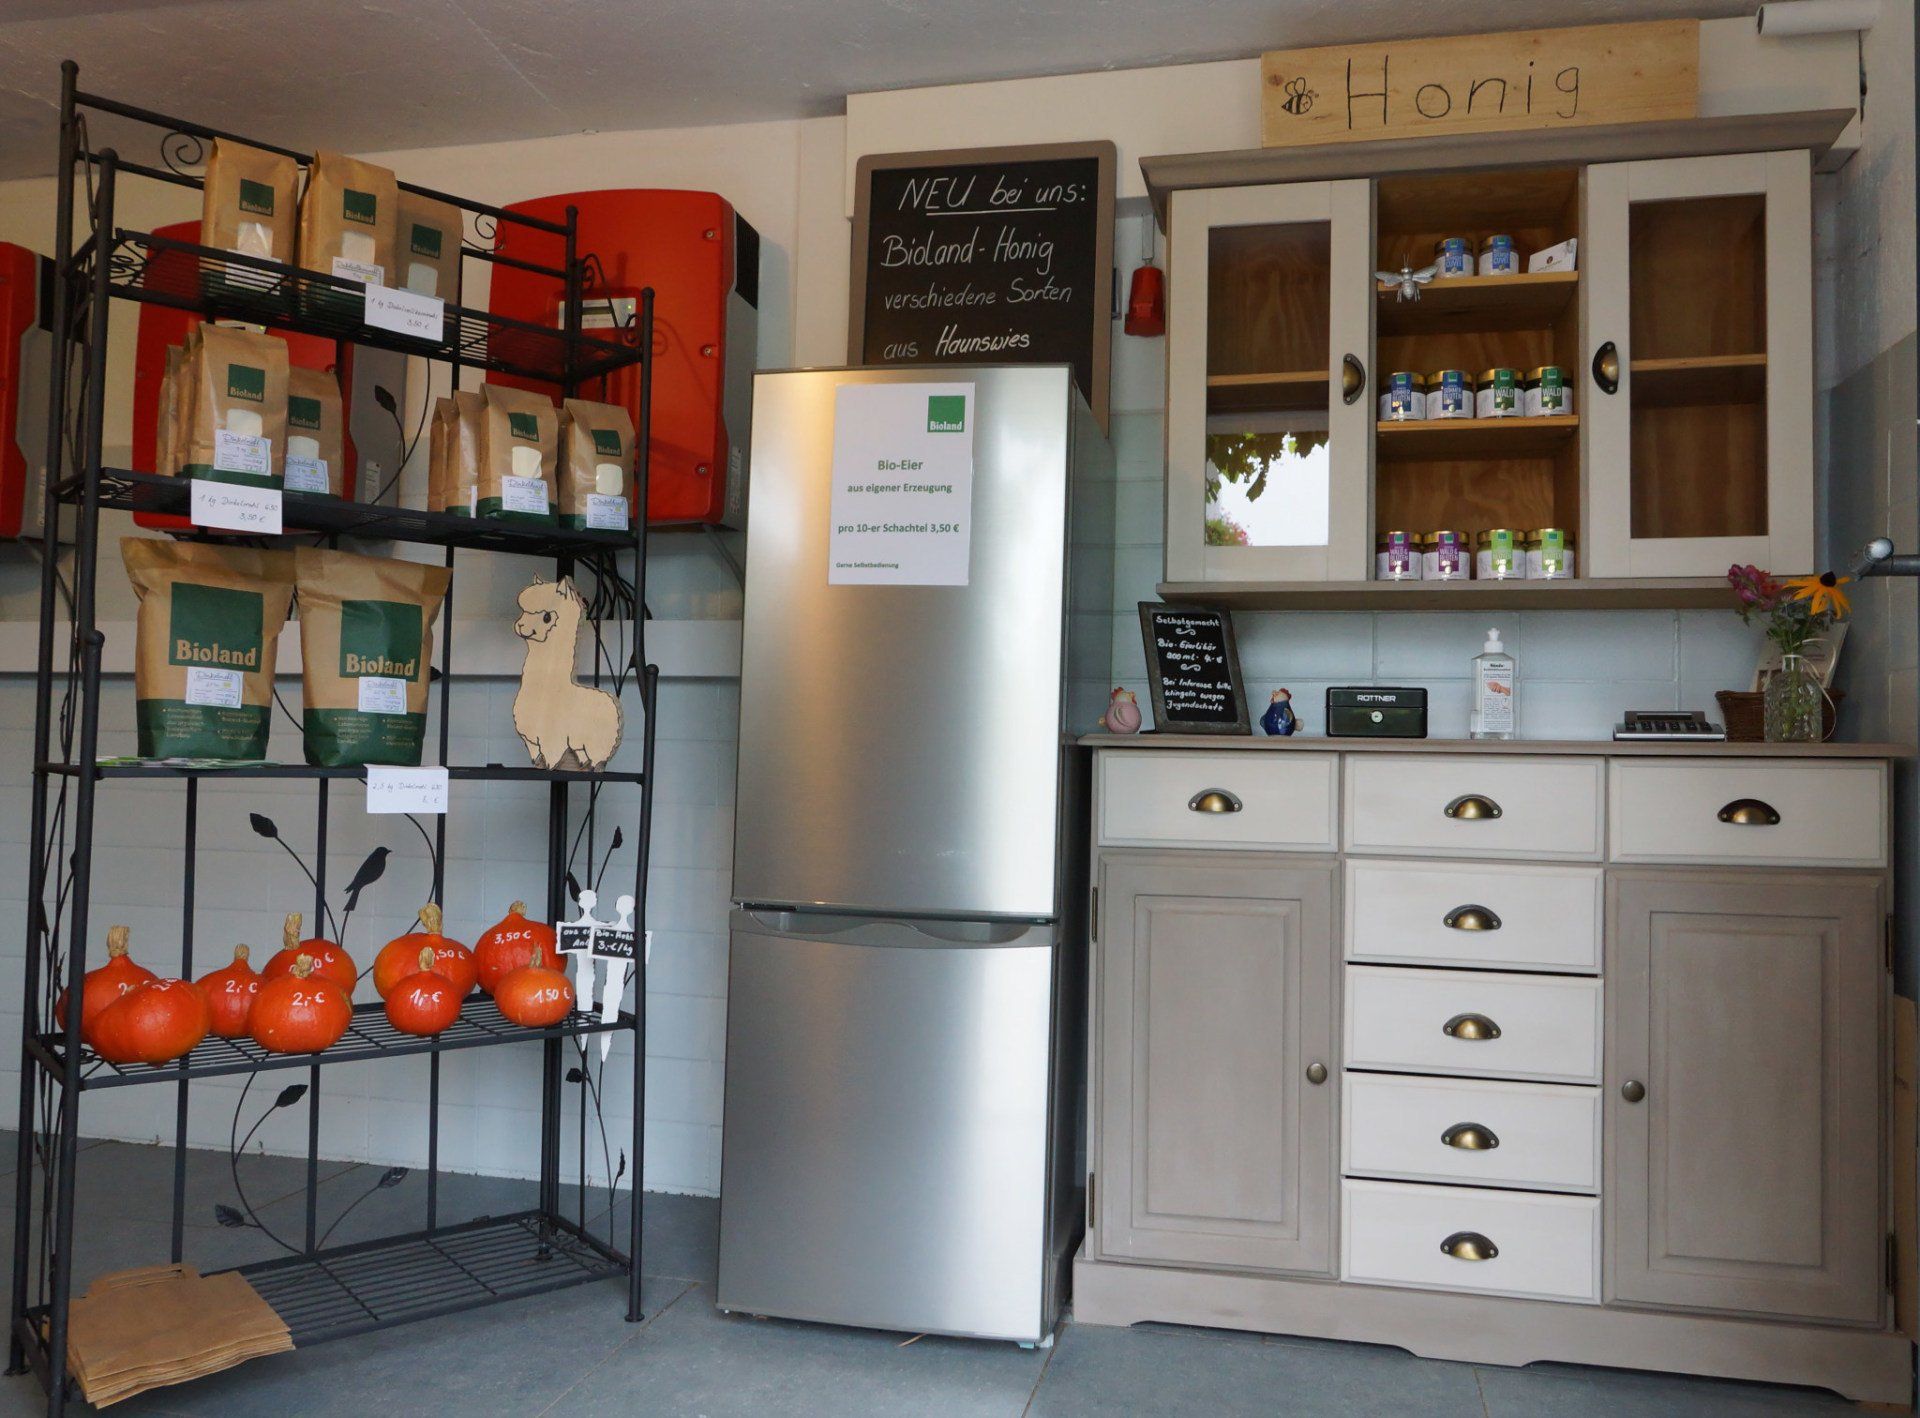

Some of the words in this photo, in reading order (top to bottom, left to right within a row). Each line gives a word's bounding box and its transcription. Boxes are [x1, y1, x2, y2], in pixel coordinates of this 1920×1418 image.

[1347, 54, 1580, 130] Honig
[898, 174, 977, 211] NEU
[990, 174, 1029, 206] bei
[1035, 183, 1087, 203] uns:
[344, 209, 375, 225] Bioland
[884, 282, 997, 310] verschiedene
[1006, 275, 1073, 303] Sorten
[884, 342, 919, 360] aus
[935, 324, 1031, 357] Haunswies
[230, 386, 264, 402] Bioland
[1495, 388, 1514, 398] WALD
[1542, 387, 1562, 397] WALD
[929, 420, 963, 431] Bioland
[877, 460, 923, 471] Bio-Eier
[847, 485, 864, 493] aus
[866, 484, 901, 495] eigener
[903, 483, 953, 495] Erzeugung
[239, 512, 257, 521] 3,50
[838, 525, 854, 535] pro
[856, 524, 881, 533] 10-er
[883, 523, 928, 533] Schachtel
[930, 524, 951, 534] 3,50
[953, 524, 960, 533] €
[853, 561, 899, 570] Selbstbedienung
[1155, 615, 1220, 628] Selbstgemacht
[176, 639, 257, 667] Bioland
[346, 653, 415, 676] Bioland
[1162, 677, 1177, 686] Bei
[1200, 692, 1225, 702] wegen
[1356, 694, 1397, 703] ROTTNER
[494, 932, 521, 944] 3,50
[522, 930, 531, 939] €
[324, 952, 334, 963] €
[314, 991, 325, 1003] €
[431, 991, 443, 1002] €
